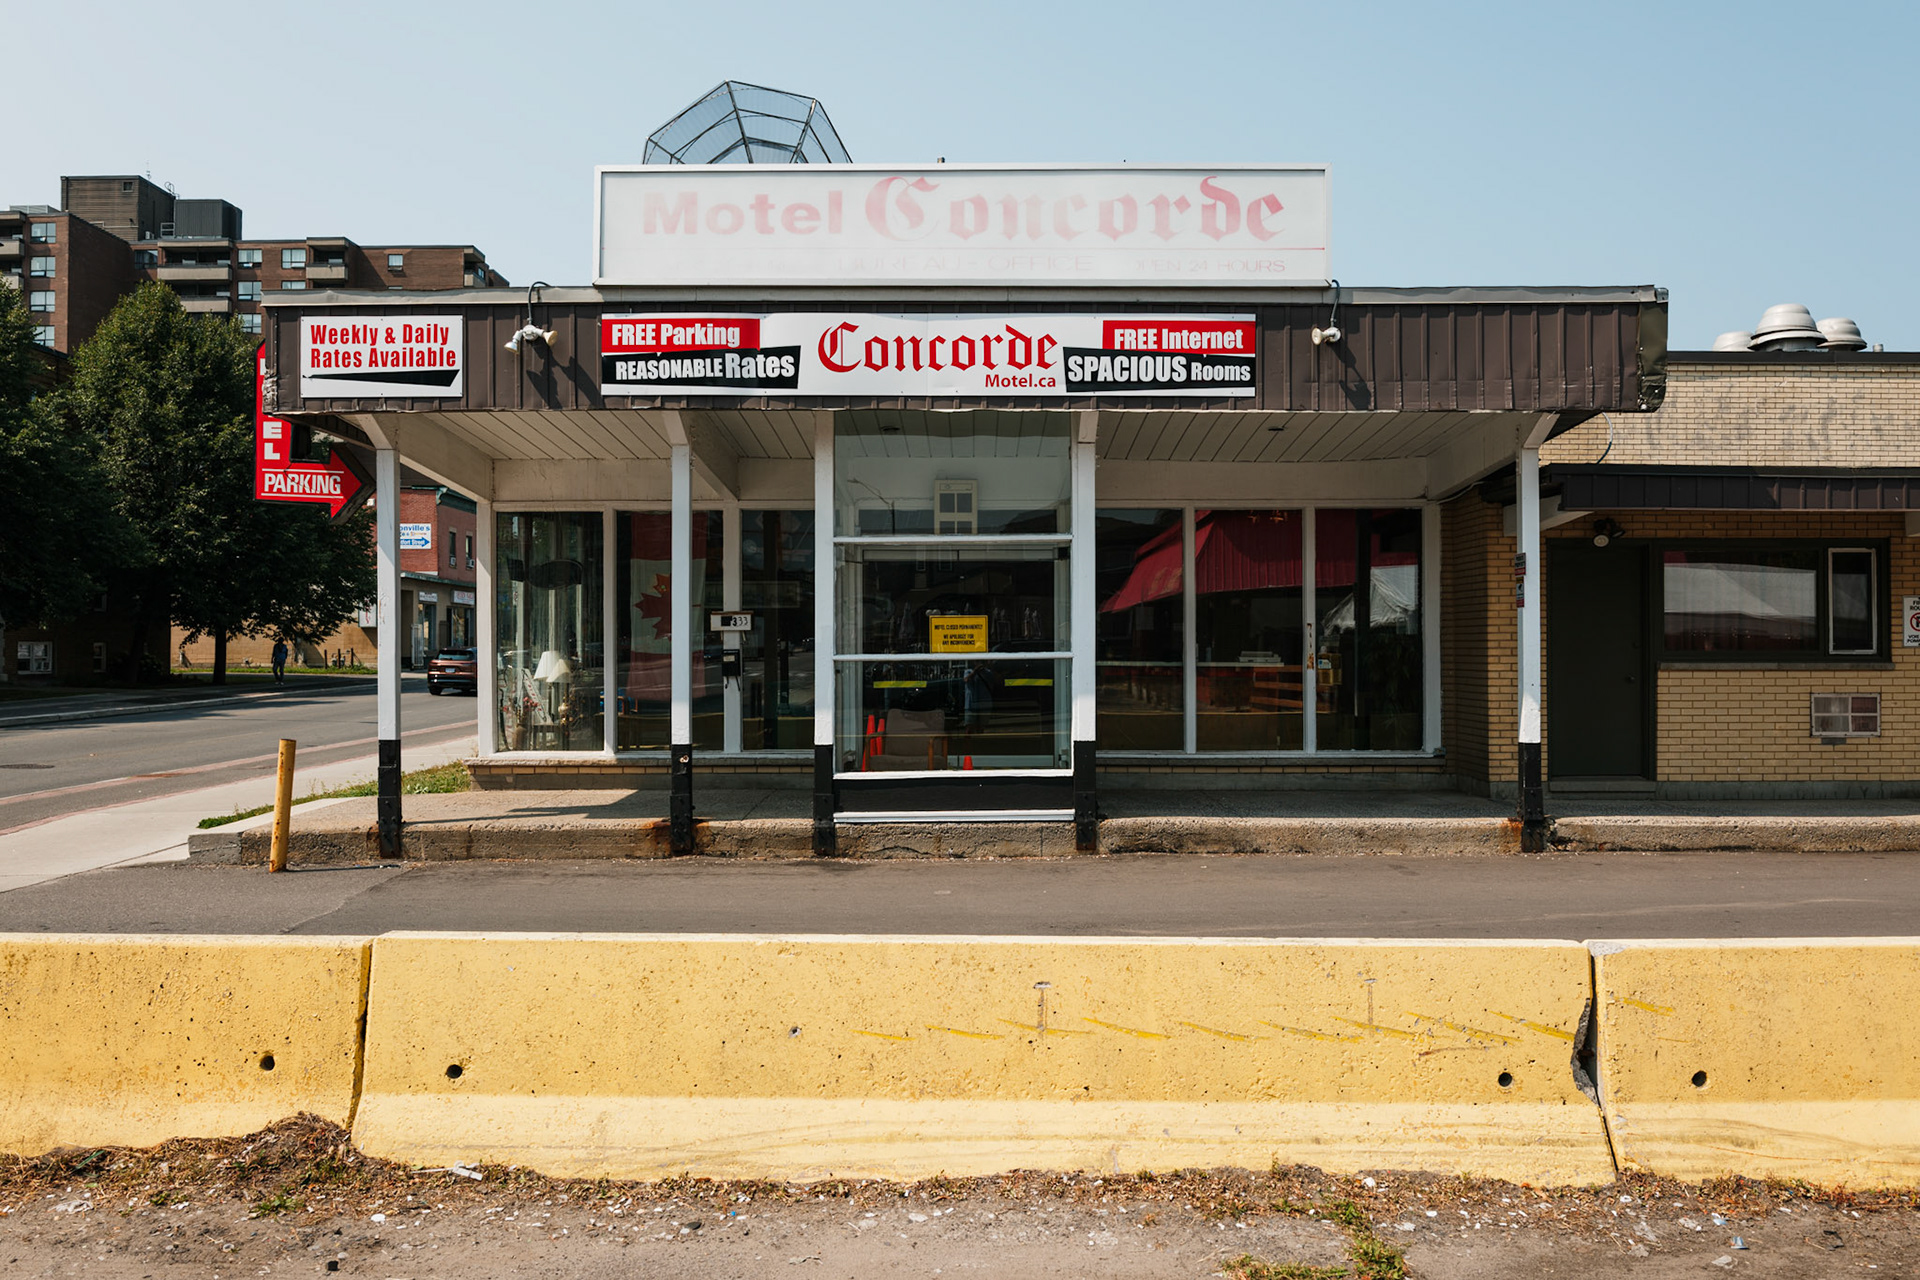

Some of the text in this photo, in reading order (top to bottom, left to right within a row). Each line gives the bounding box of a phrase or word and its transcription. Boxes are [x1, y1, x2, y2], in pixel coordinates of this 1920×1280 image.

[642, 175, 1286, 242] Motel Concorde
[987, 255, 1094, 271] OFFICE
[1188, 259, 1208, 273] 24
[1216, 258, 1286, 273] HOURS
[310, 323, 450, 346] Weekly & Daily
[611, 323, 741, 348] FREE Parking
[1114, 328, 1244, 350] FREE Internet
[310, 347, 457, 368] Rates Available
[817, 321, 1058, 373] Concorde
[615, 352, 796, 381] REASONABLE Rates
[1067, 355, 1251, 383] SPACIOUS Rooms
[984, 373, 1057, 388] Motel.ca
[263, 473, 342, 494] PARKING
